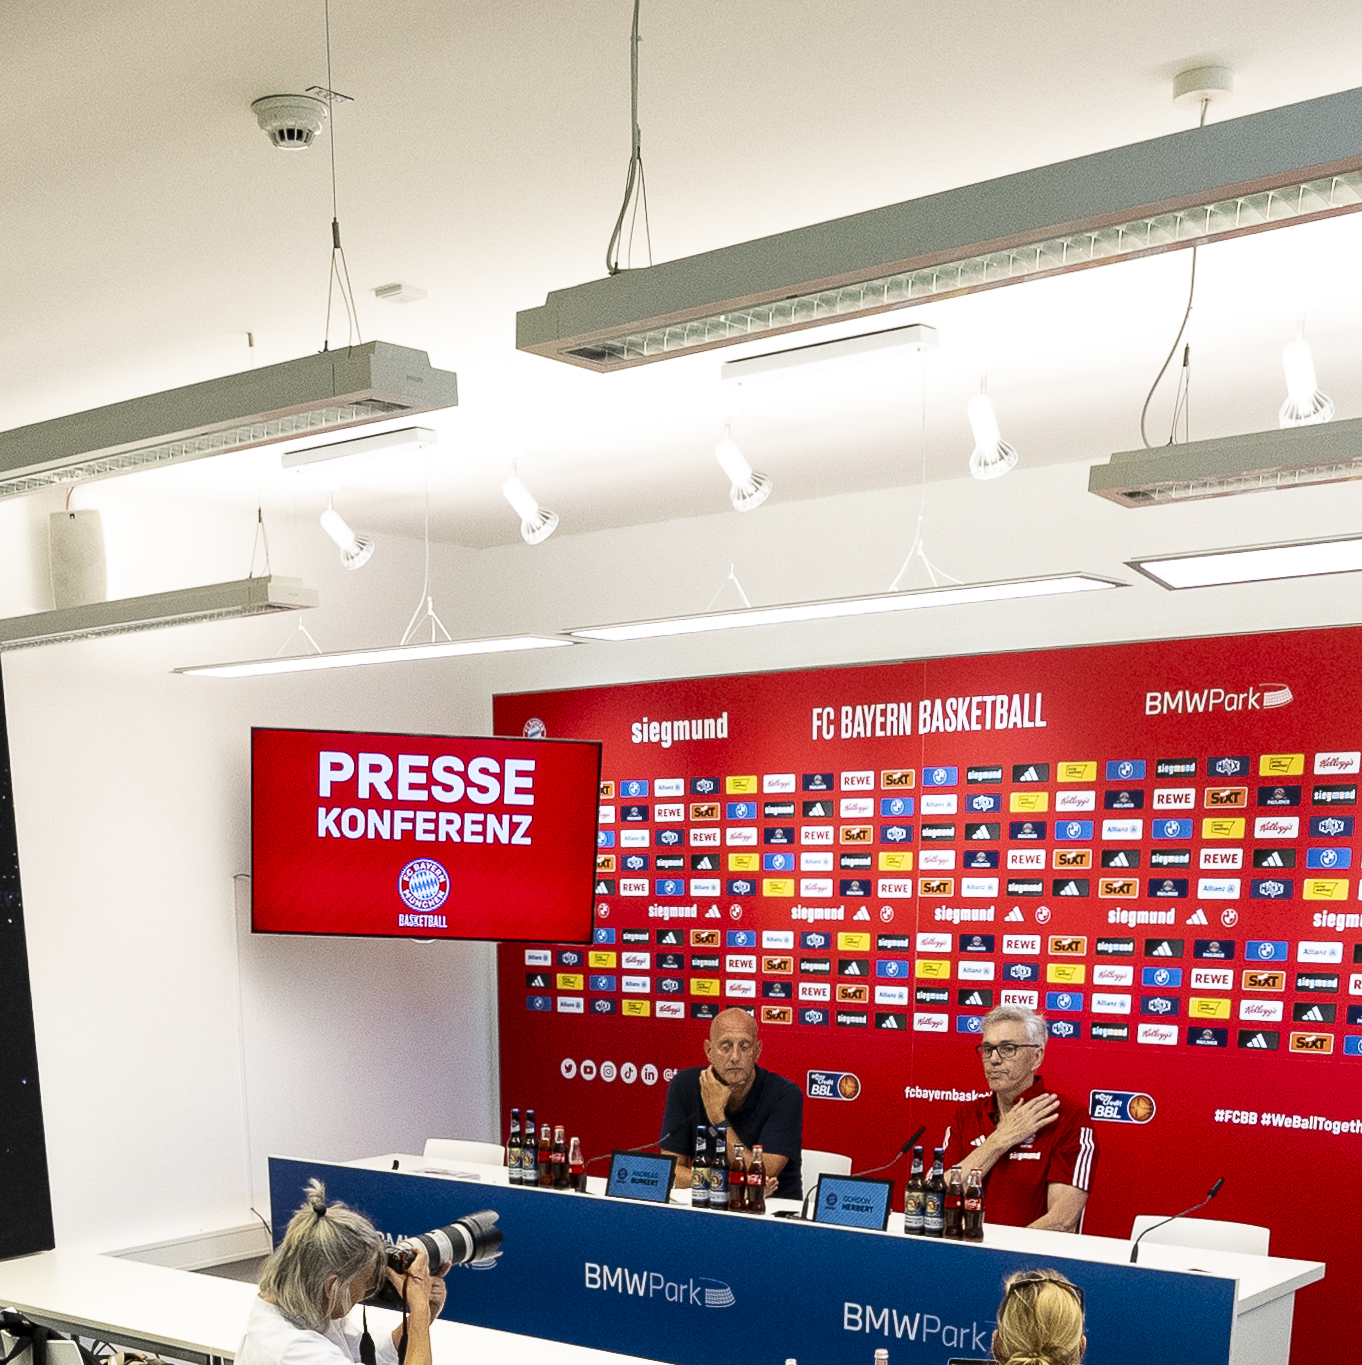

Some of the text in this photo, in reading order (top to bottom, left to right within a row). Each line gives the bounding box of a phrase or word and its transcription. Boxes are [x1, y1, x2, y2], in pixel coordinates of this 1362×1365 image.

[1145, 687, 1260, 715] BMWPark
[811, 692, 1047, 740] FC BAYERN BASKETBALL
[631, 711, 728, 748] siegmund
[319, 751, 536, 806] PRESSE
[844, 776, 870, 785] REWE
[1157, 793, 1191, 804] REWE
[657, 808, 681, 817] REWE
[317, 806, 533, 846] KONFERENZ
[693, 833, 717, 842] REWE
[804, 831, 829, 840] REWE
[1011, 854, 1041, 864] REWE
[1203, 854, 1238, 864] REWE
[413, 862, 446, 883] BAYERN
[623, 883, 646, 892] REWE
[881, 884, 907, 893] REWE
[648, 903, 698, 921] siegmund
[791, 904, 844, 923] siegmund
[934, 905, 995, 924] siegmund
[1107, 907, 1175, 928] siegmund
[398, 913, 448, 928] BASKETBALL
[1006, 940, 1036, 950] REWE
[729, 959, 753, 968] REWE
[1195, 974, 1229, 984] REWE
[801, 987, 827, 996] REWE
[1004, 994, 1035, 1004] REWE
[811, 1084, 834, 1097] BBL
[1094, 1105, 1122, 1119] BBL
[1214, 1108, 1258, 1125] #FCBB
[583, 1261, 702, 1306] BMWPark
[843, 1301, 987, 1352] BMWPark
